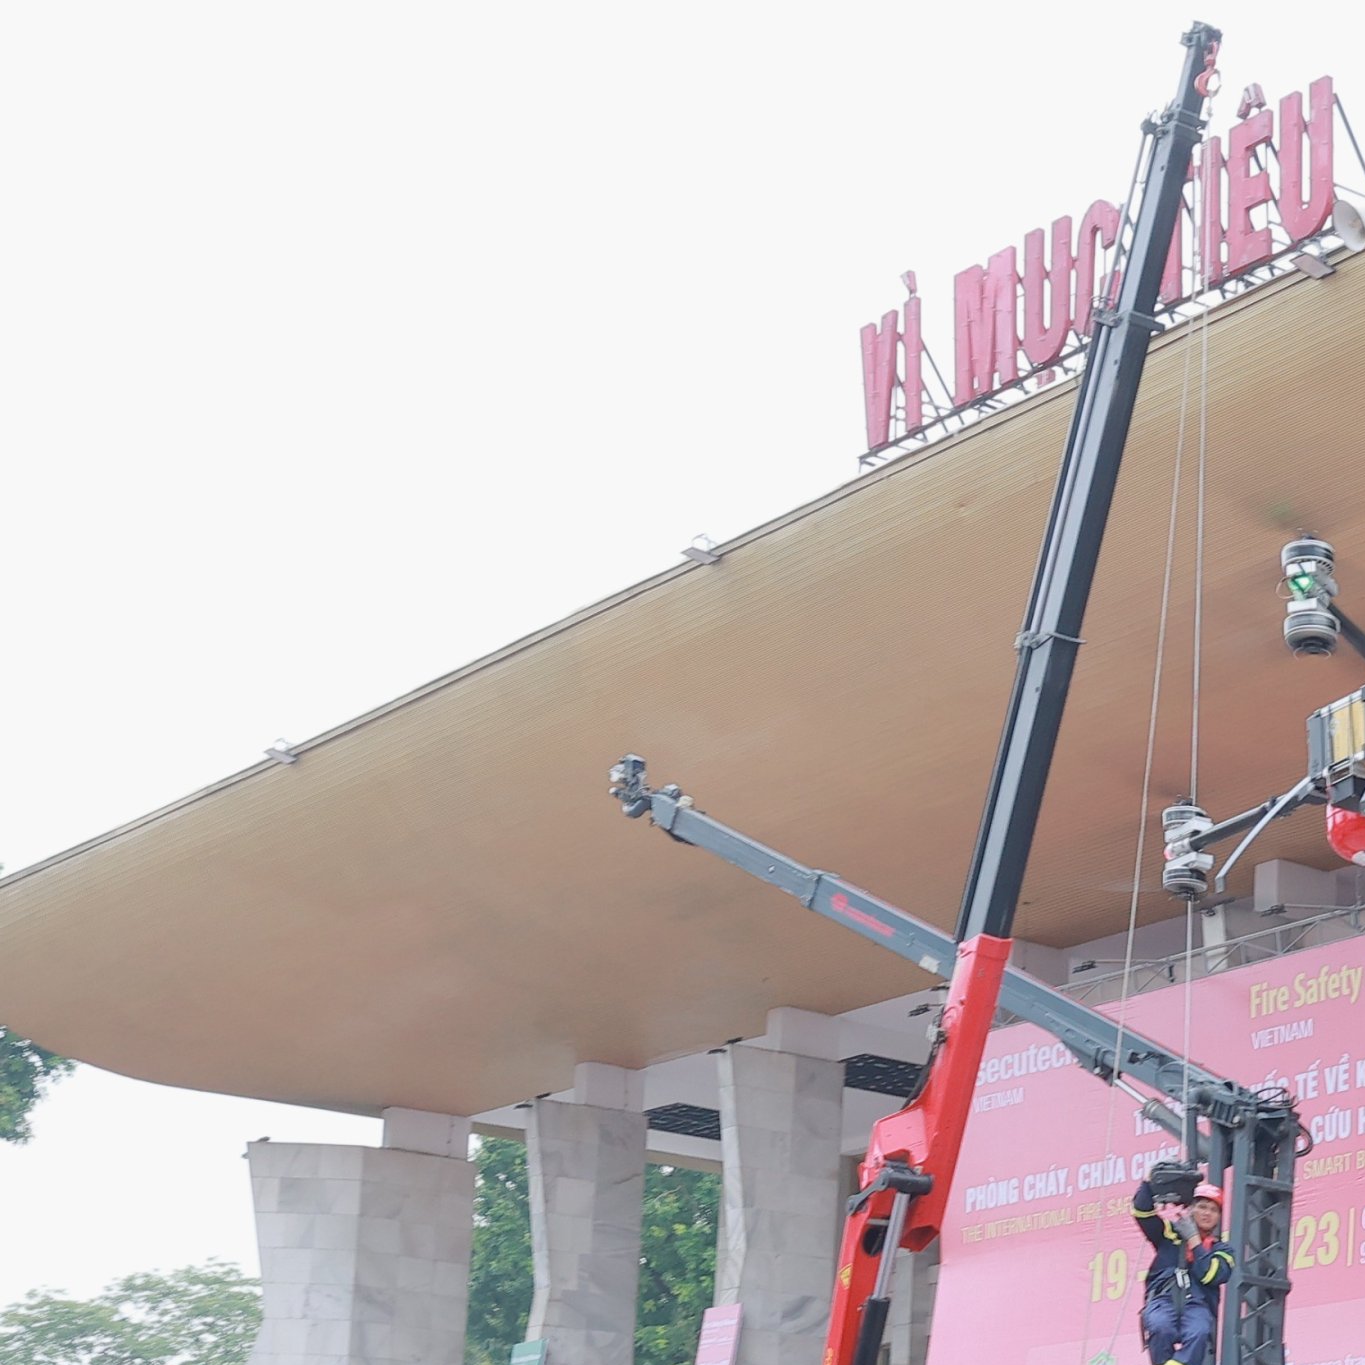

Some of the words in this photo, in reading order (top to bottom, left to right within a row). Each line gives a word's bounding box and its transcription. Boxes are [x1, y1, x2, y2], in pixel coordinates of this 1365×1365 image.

[859, 269, 921, 451] VÌ
[1160, 75, 1334, 305] IÊU
[1250, 980, 1289, 1019] Fire
[1293, 964, 1363, 1004] Safety
[1250, 1019, 1314, 1050] VIETNAM
[976, 1042, 1080, 1087] secutec
[1295, 1059, 1321, 1101] TẾ
[1324, 1053, 1351, 1096] VỀ
[1310, 1104, 1352, 1146] CỨU
[964, 1176, 1020, 1214] PHÒNG
[1023, 1163, 1074, 1199] CHÁY,
[1078, 1154, 1127, 1192] CHỮA
[1303, 1152, 1352, 1180] SMART
[960, 1224, 983, 1245] THE
[984, 1208, 1075, 1241] INTERNATIONAL
[1077, 1202, 1104, 1226] FIRE
[1090, 1248, 1128, 1303] 19
